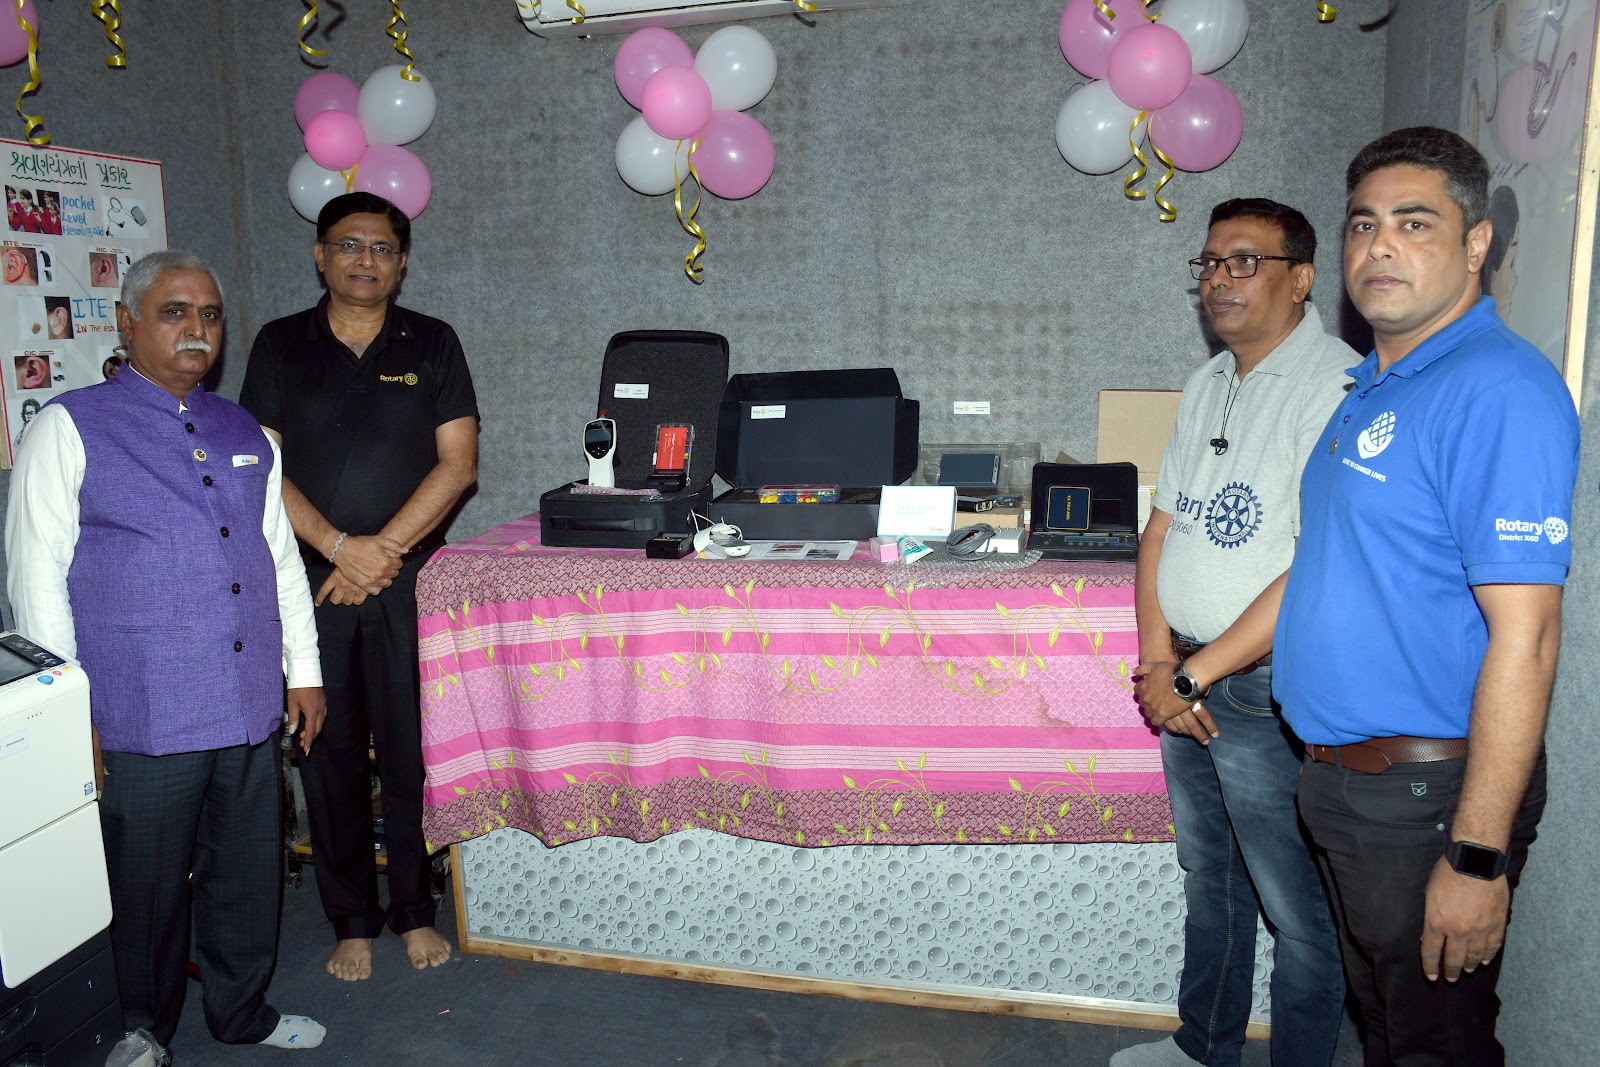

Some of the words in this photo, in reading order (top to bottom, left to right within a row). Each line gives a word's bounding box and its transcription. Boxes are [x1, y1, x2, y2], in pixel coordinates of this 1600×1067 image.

[62, 211, 88, 225] Level
[380, 374, 404, 383] Rotary
[1370, 470, 1387, 483] LIVES
[1226, 488, 1250, 500] ROTARY
[1211, 521, 1250, 542] INTERNATIONAL
[1495, 518, 1543, 536] Rotary
[87, 980, 92, 989] 1
[95, 1034, 102, 1044] 2
